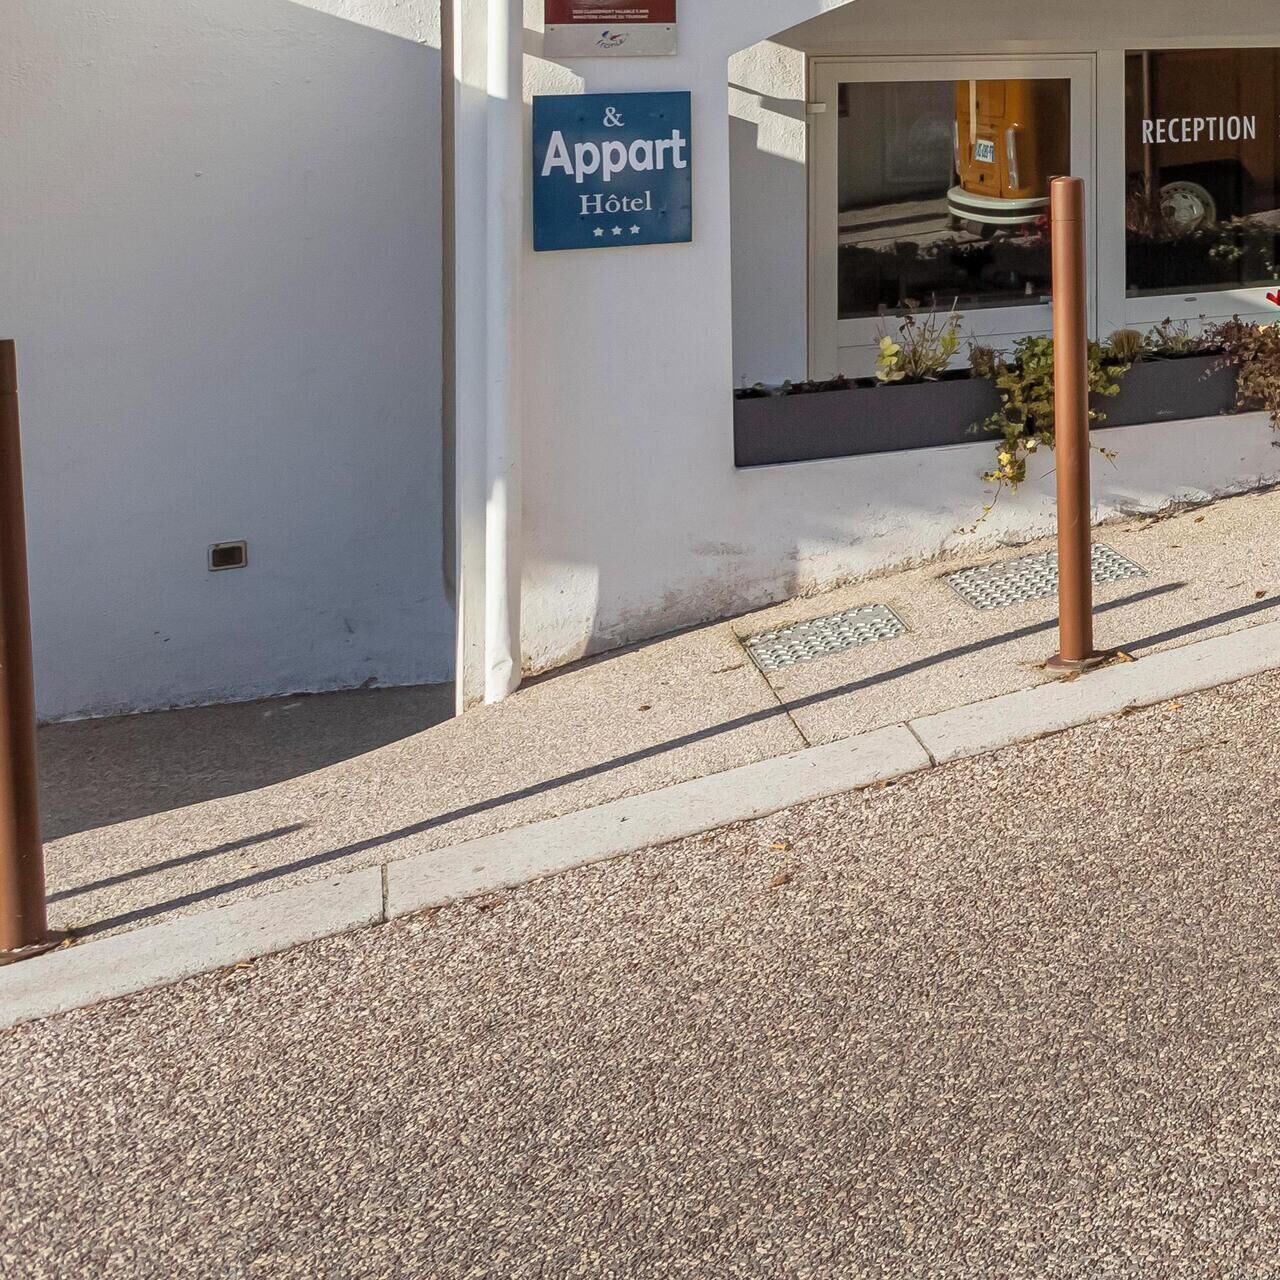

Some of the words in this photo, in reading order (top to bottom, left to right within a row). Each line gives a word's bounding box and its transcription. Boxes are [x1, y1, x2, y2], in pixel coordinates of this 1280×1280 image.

[603, 107, 625, 127] &
[1142, 115, 1256, 144] RECEPTION
[541, 129, 687, 183] Appart
[578, 190, 653, 215] Hôtel
